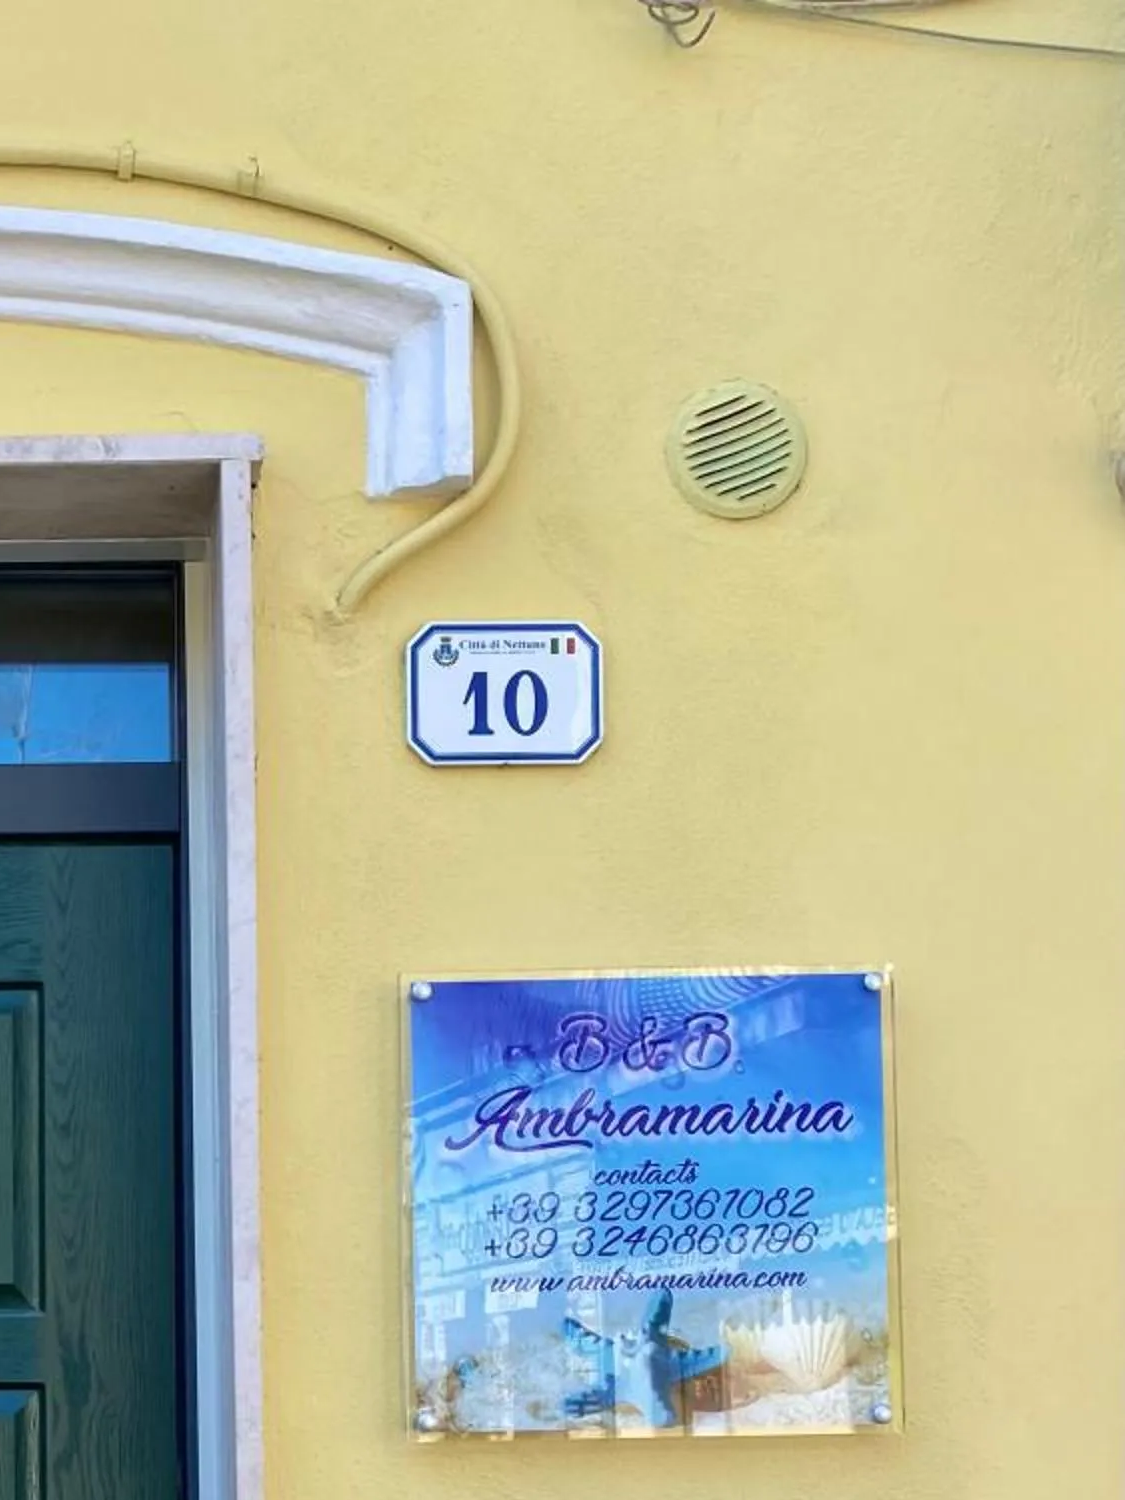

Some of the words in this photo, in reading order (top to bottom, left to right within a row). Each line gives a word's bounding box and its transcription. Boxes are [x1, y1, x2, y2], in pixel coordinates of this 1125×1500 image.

[490, 640, 500, 649] di
[503, 640, 546, 649] Nettuno
[463, 670, 549, 737] 10
[560, 1014, 609, 1073] B
[622, 1016, 672, 1072] &
[682, 1011, 732, 1071] B
[444, 1085, 854, 1152] Ambramarina
[594, 1158, 700, 1186] contacts
[486, 1191, 560, 1223] +39
[574, 1188, 815, 1223] 3297361082
[484, 1226, 558, 1259] +39
